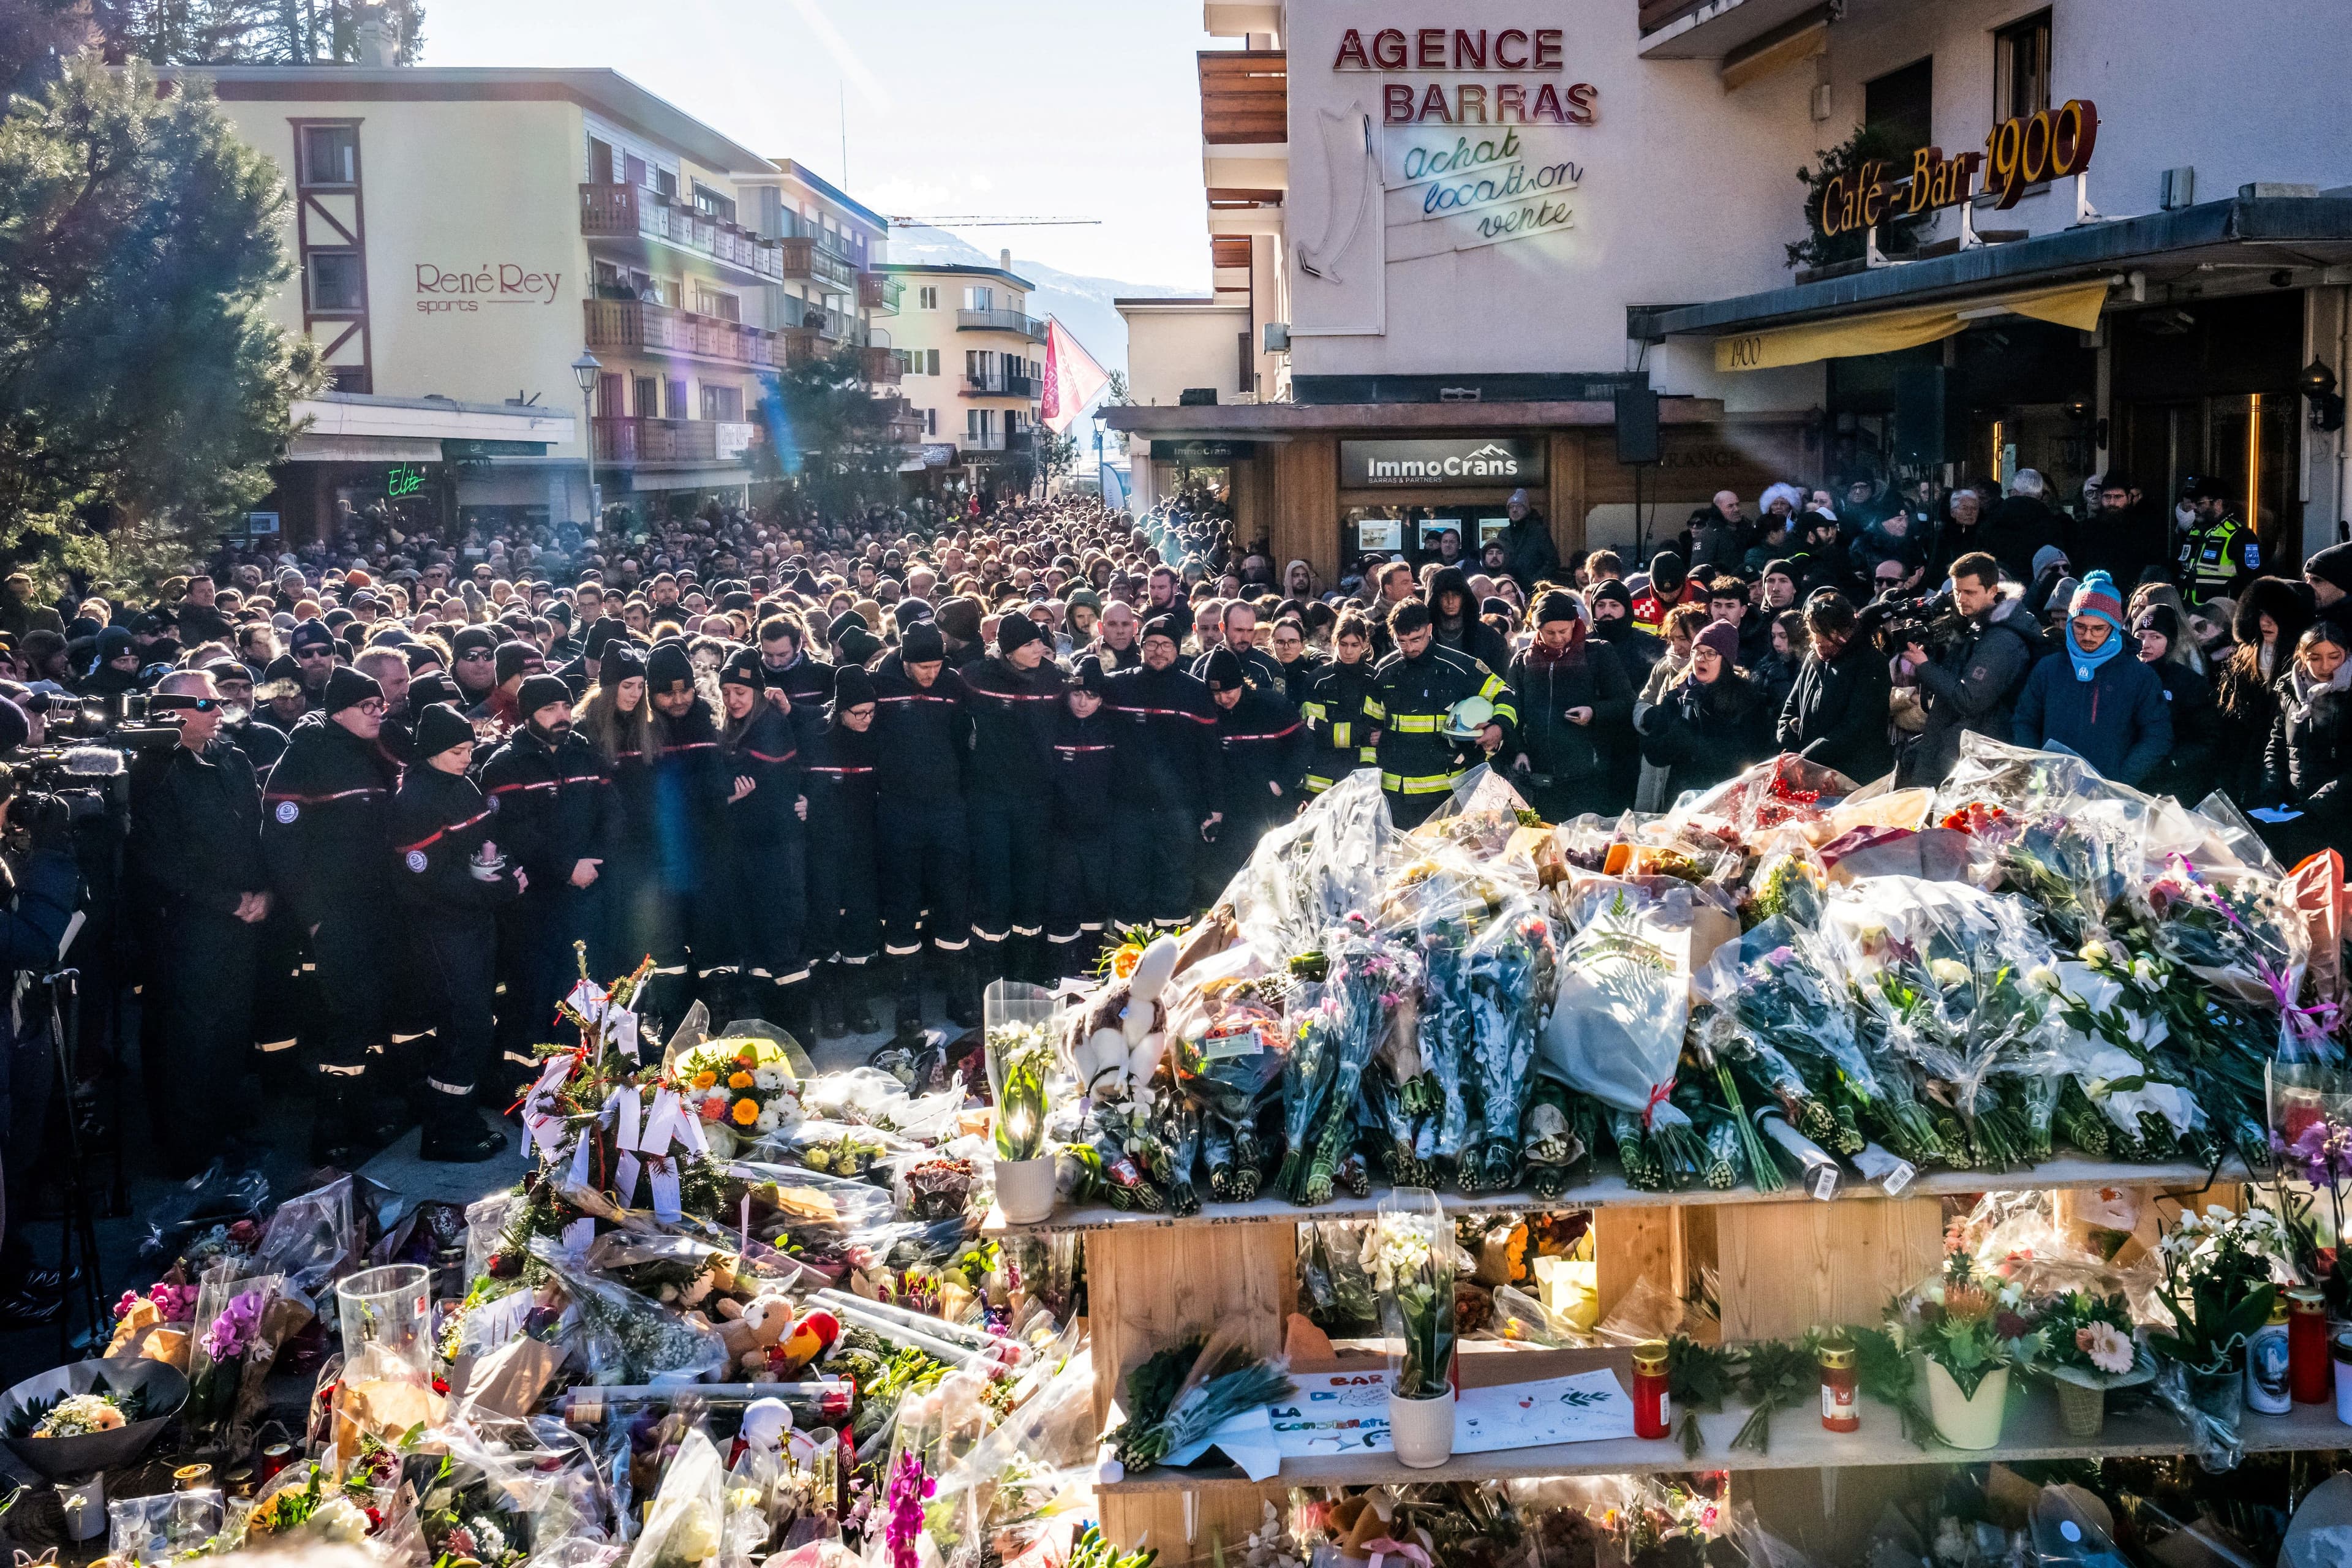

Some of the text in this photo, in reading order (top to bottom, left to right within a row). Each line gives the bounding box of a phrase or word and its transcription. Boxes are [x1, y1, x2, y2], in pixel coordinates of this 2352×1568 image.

[1333, 28, 1563, 69] AGENCE
[1383, 83, 1599, 124] BARRAS
[1404, 126, 1520, 179] achat
[1980, 99, 2090, 205] 1900
[1425, 160, 1583, 214] location
[1477, 201, 1572, 238] vente
[415, 263, 562, 304] René Rey
[417, 298, 478, 315] sports
[1731, 337, 1761, 368] 1900
[388, 461, 426, 496] Elite
[1368, 456, 1518, 477] ImmoCrans
[1310, 1392, 1338, 1401] DE
[1330, 1374, 1384, 1386] BAR
[1270, 1407, 1302, 1418] LA
